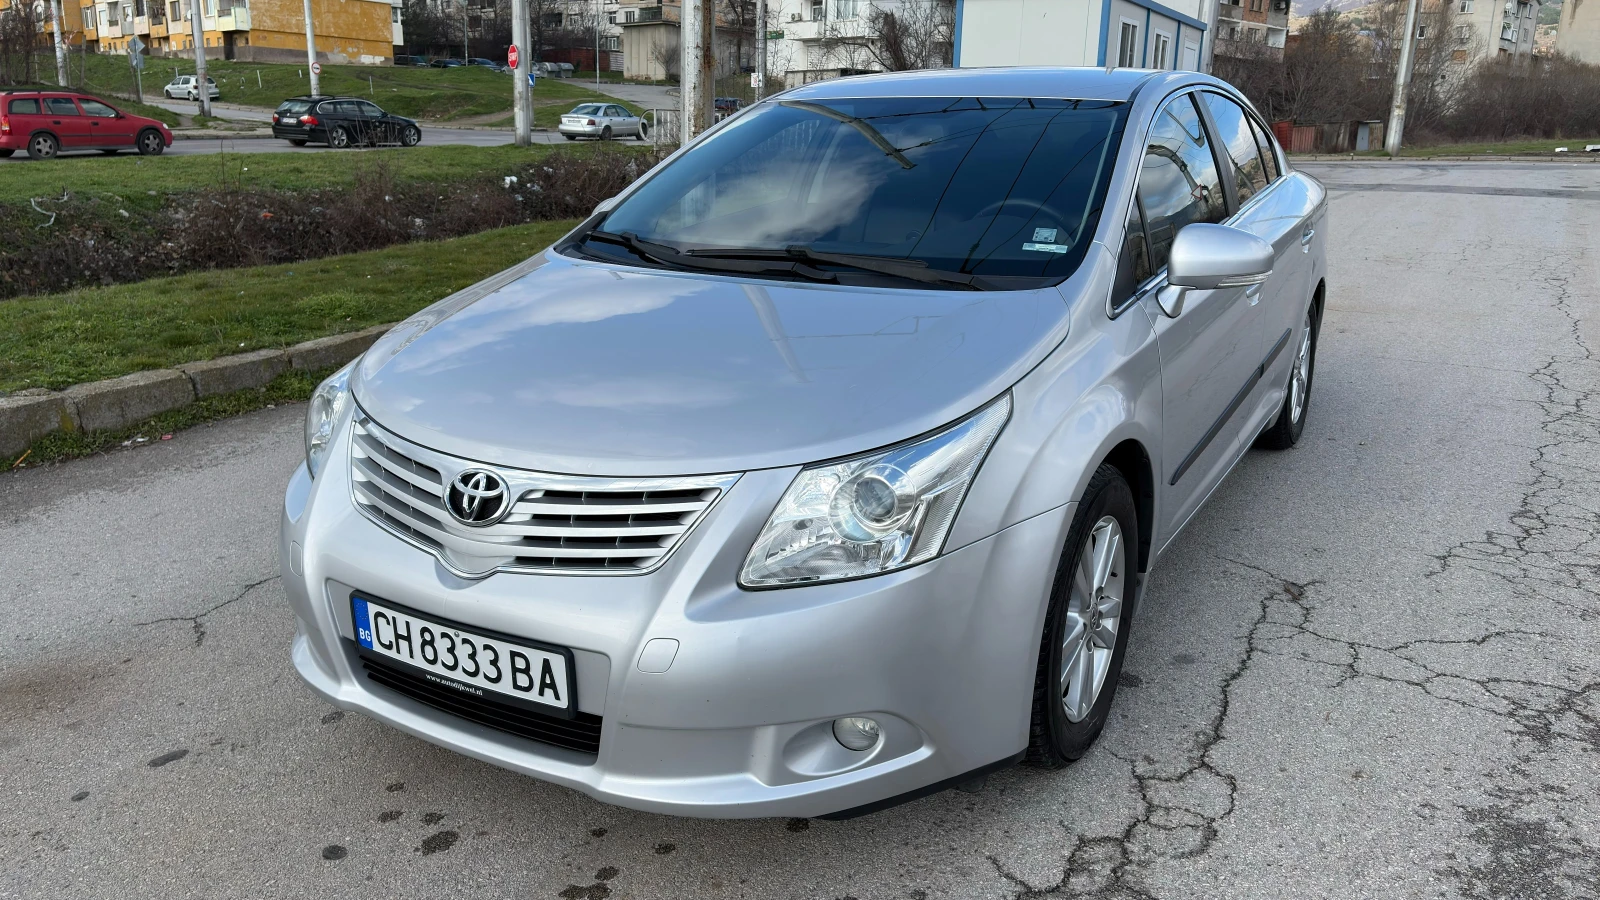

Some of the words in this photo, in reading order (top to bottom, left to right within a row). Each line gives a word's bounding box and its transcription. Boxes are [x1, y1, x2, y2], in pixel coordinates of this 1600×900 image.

[359, 627, 371, 642] BG
[373, 611, 414, 659] CH
[419, 626, 503, 684] 8333
[509, 649, 562, 701] BA
